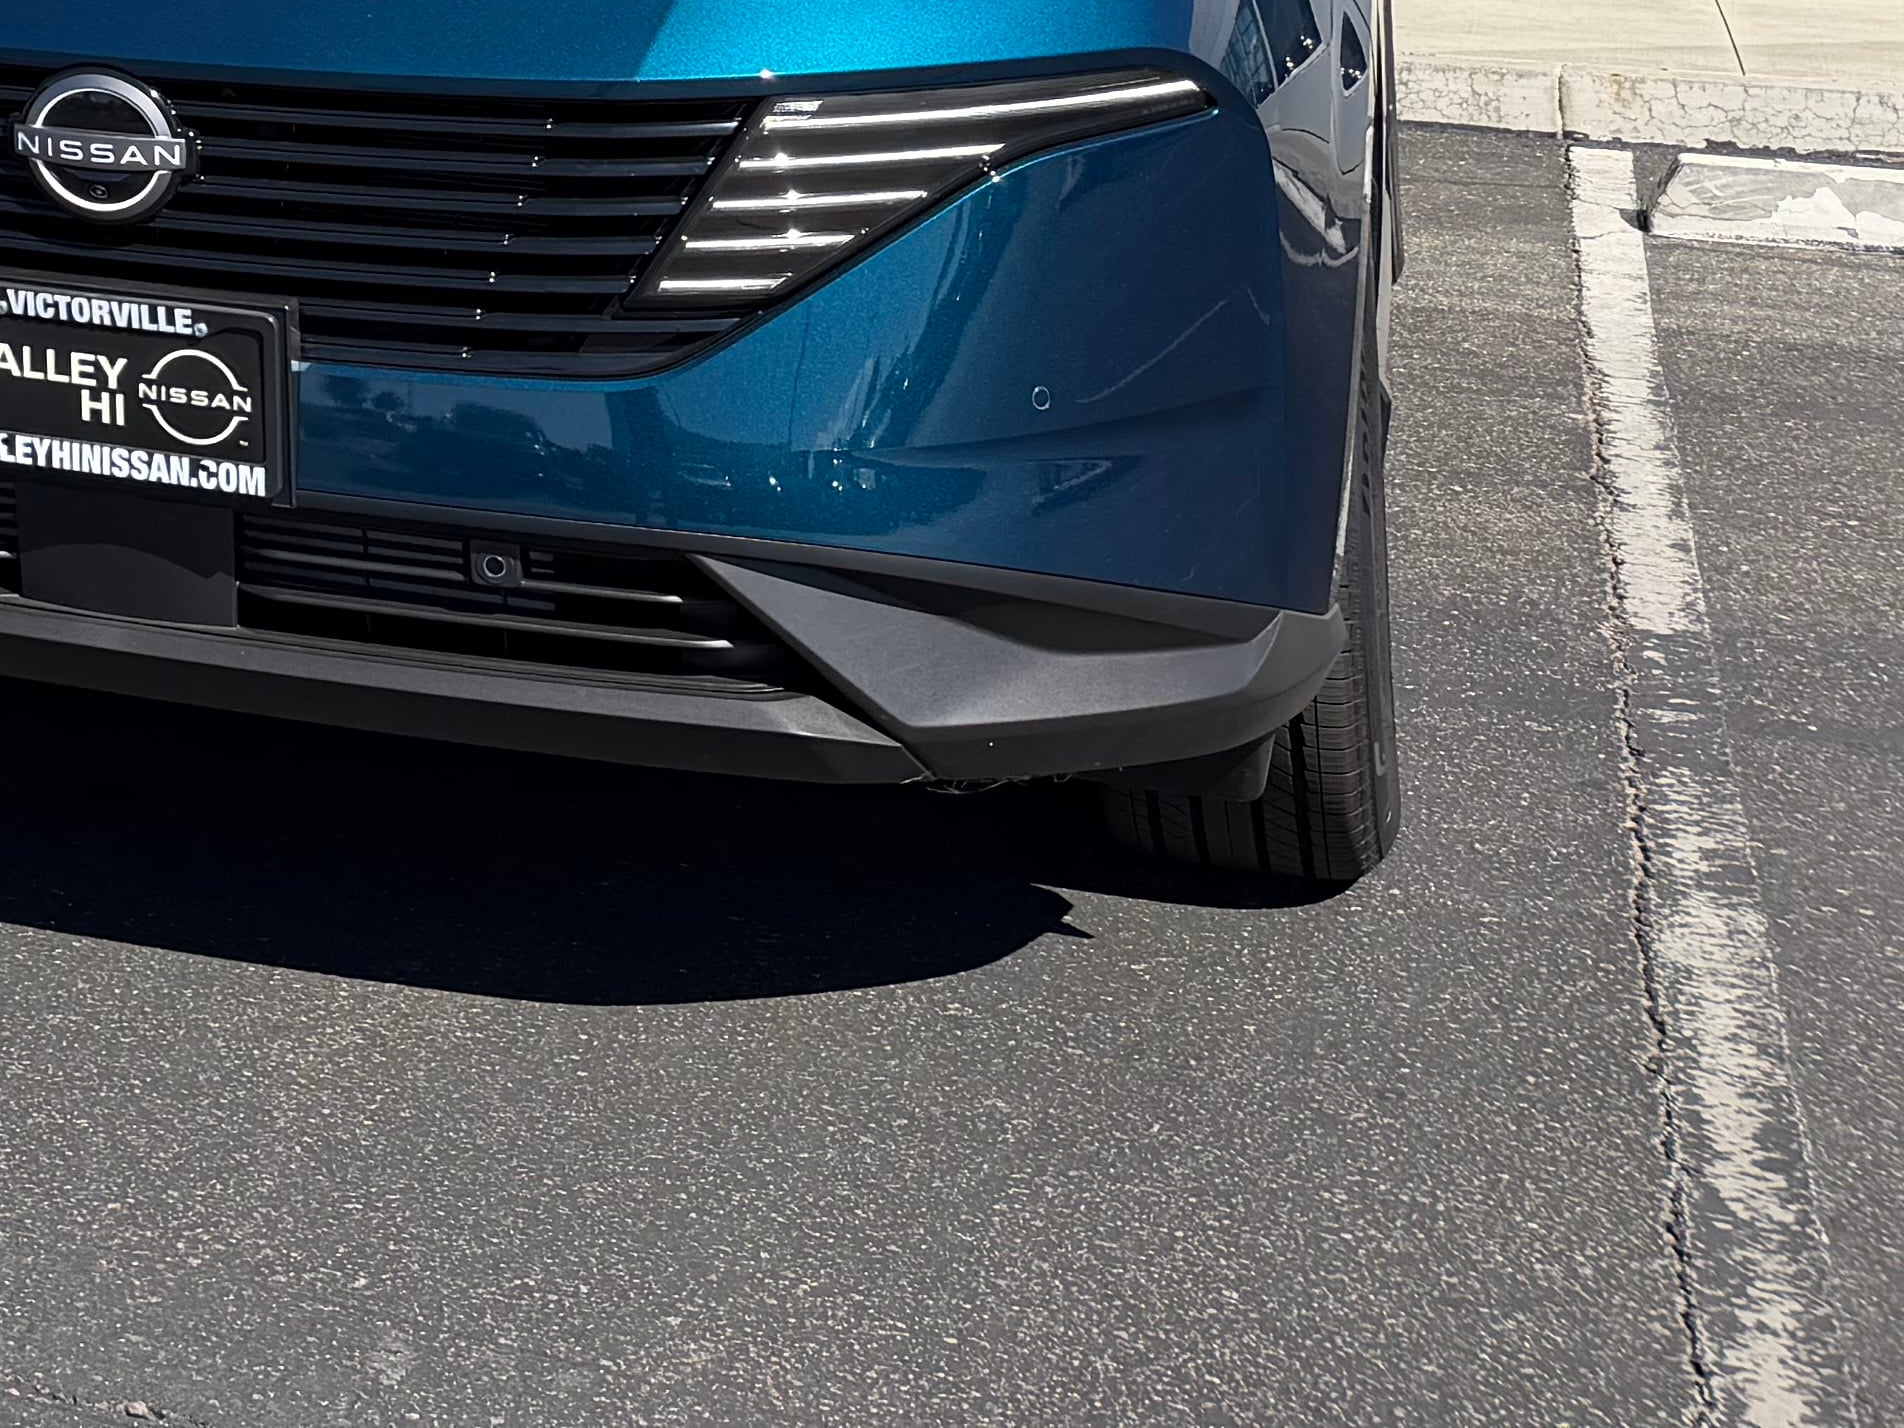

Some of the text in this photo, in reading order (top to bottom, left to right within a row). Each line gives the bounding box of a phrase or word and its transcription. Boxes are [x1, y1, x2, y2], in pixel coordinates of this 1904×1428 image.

[17, 131, 182, 166] NISSAN
[6, 288, 194, 336] VICTORVILLE
[80, 389, 126, 426] HI
[138, 382, 252, 413] NISSAN
